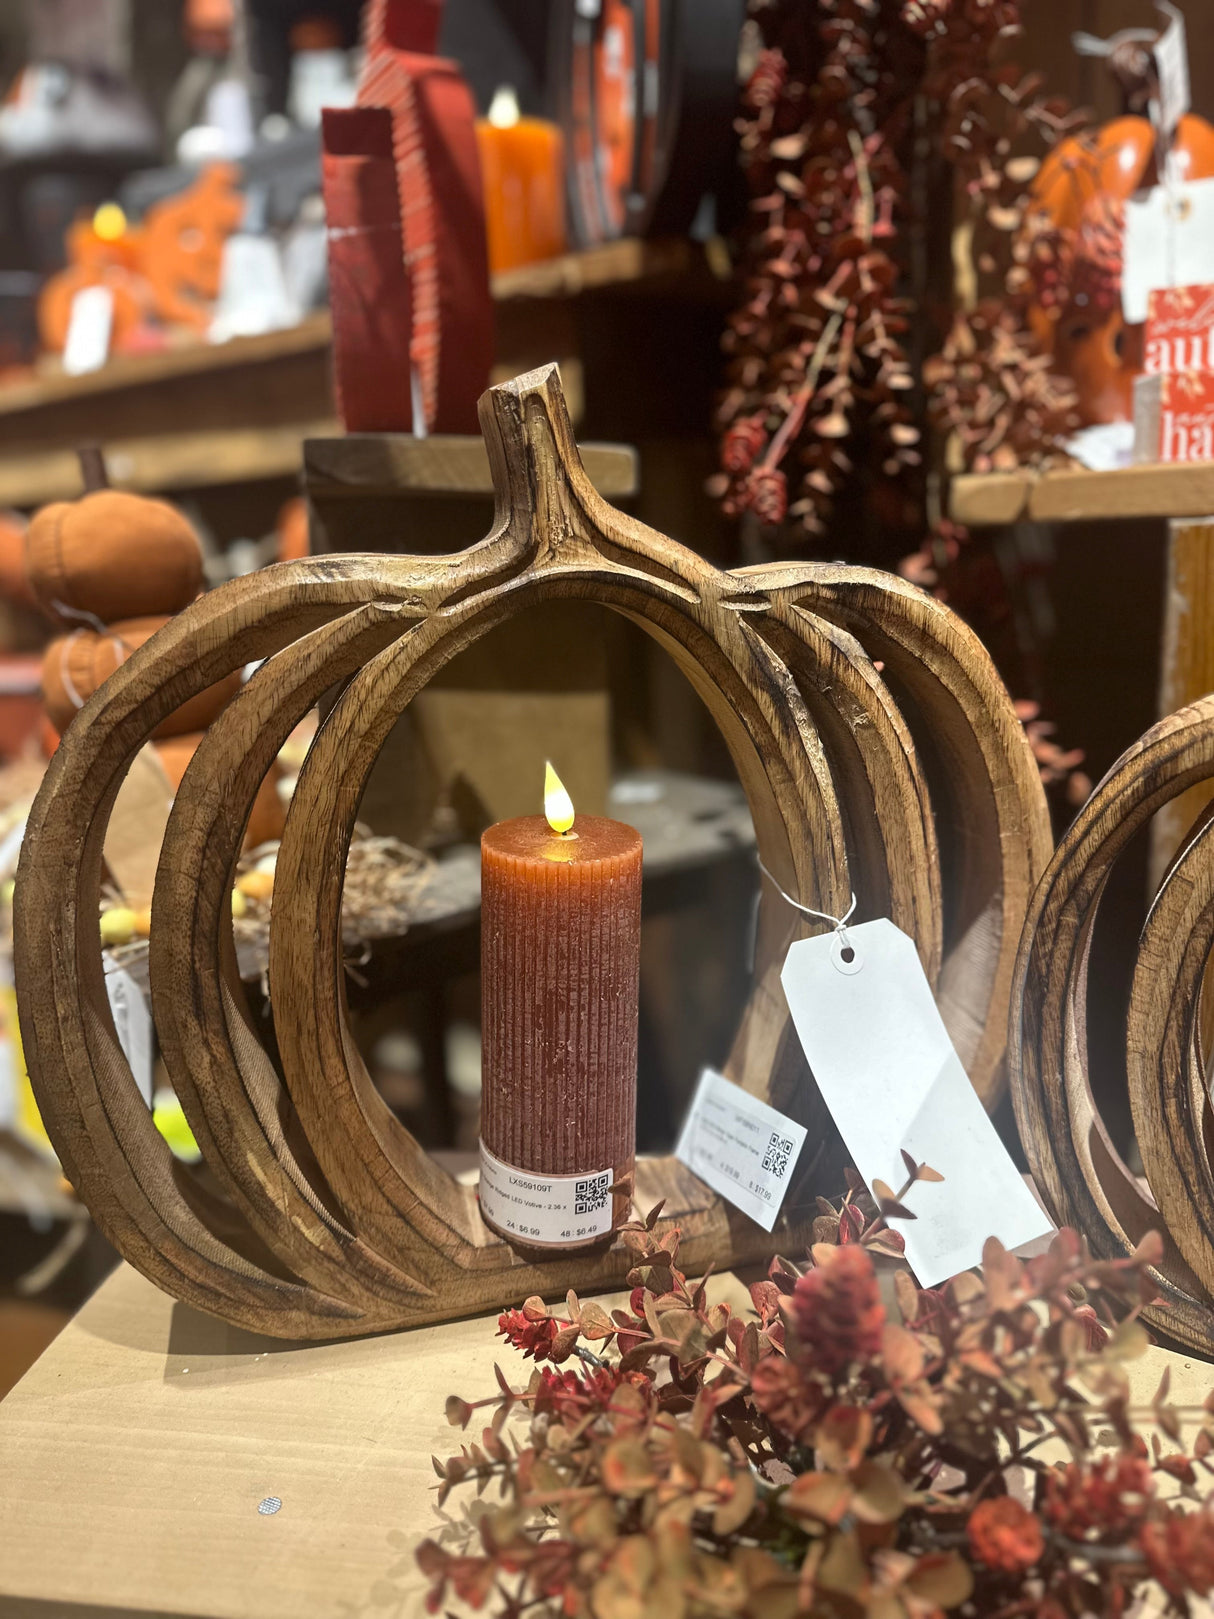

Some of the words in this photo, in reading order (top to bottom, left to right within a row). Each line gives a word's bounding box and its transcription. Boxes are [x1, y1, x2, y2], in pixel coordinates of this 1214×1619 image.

[509, 1176, 552, 1192] LXS59109T
[755, 1184, 772, 1200] $17.99
[511, 1195, 523, 1204] LED
[524, 1200, 542, 1209] Votive
[519, 1224, 540, 1236] $6.99
[576, 1225, 598, 1236] $6.49
